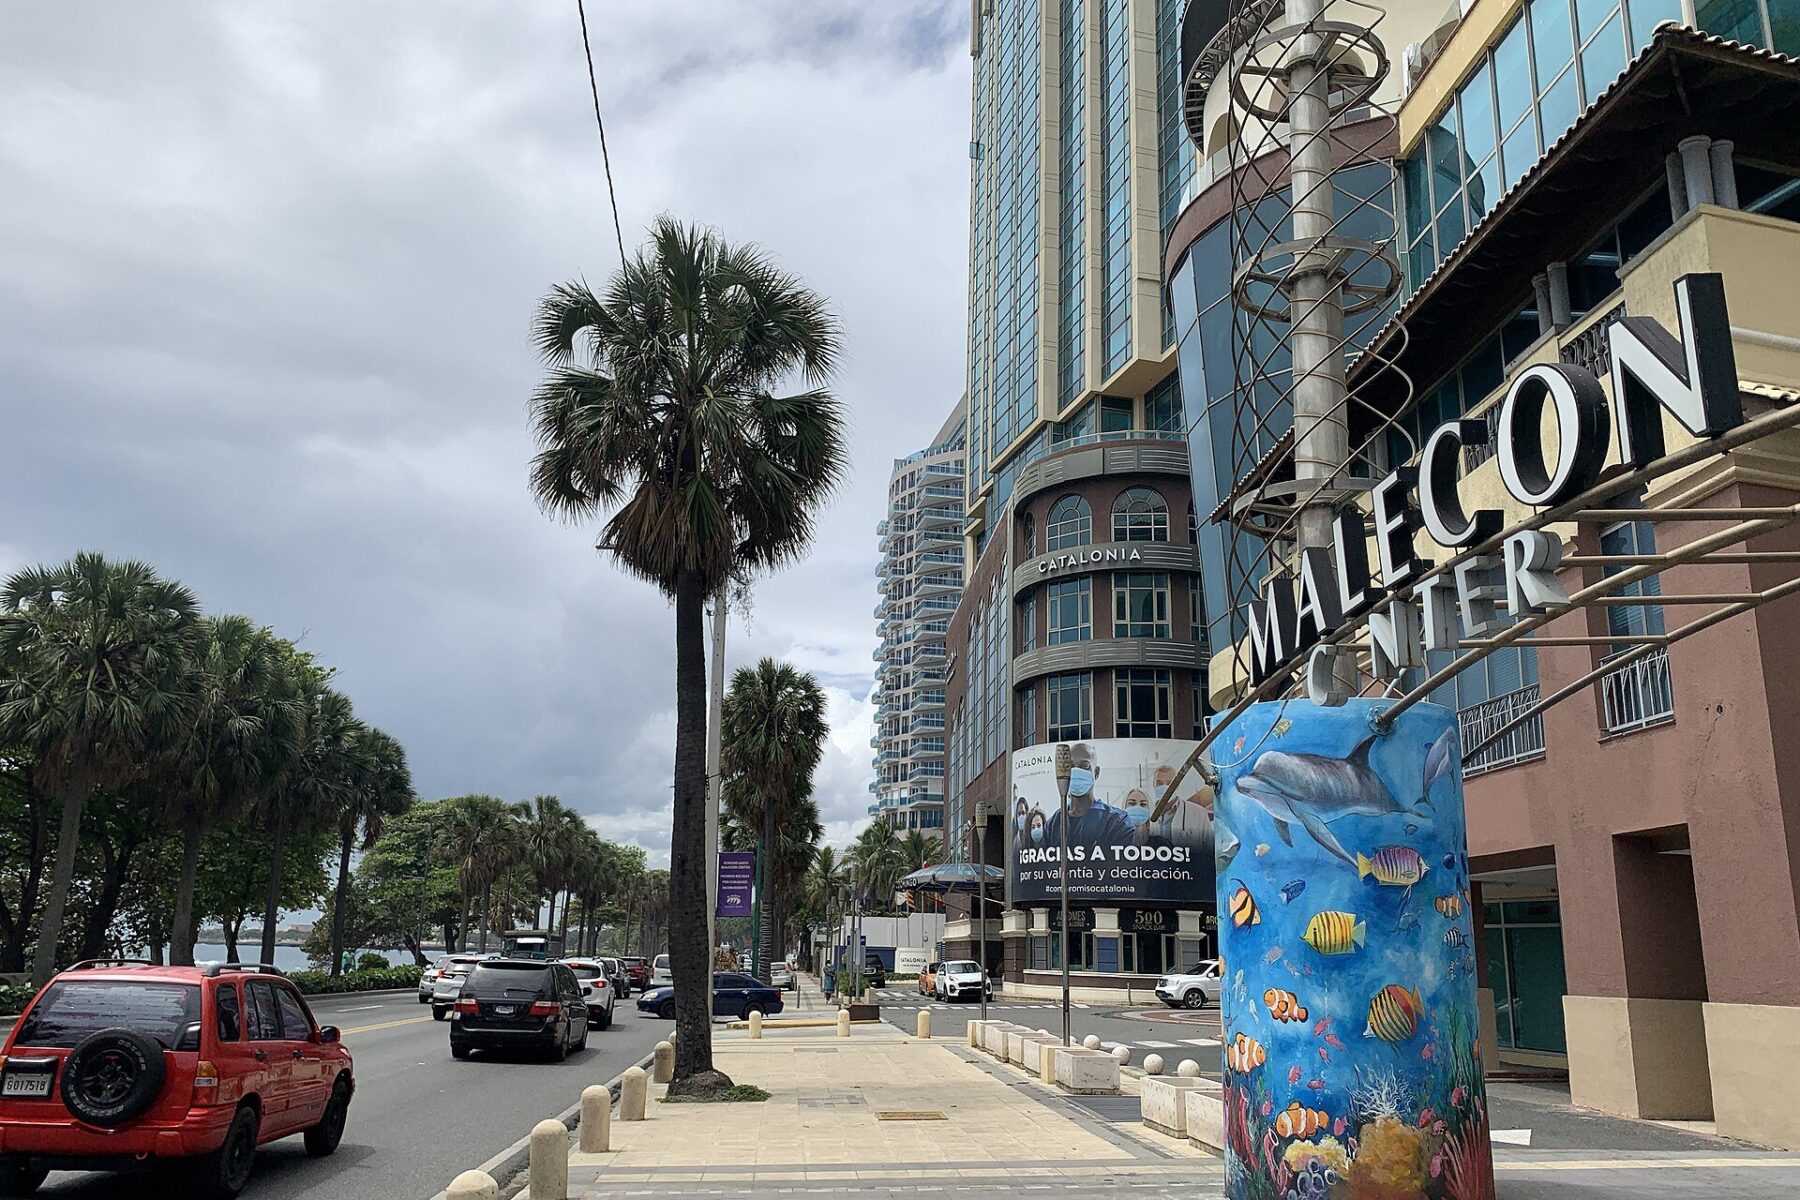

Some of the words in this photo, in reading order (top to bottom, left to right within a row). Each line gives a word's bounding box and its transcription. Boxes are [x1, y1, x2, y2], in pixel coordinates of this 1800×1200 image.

[1248, 272, 1744, 687] MALECON
[1038, 548, 1141, 573] CATALONIA
[1308, 529, 1570, 707] CNTER
[1015, 756, 1053, 769] CATALONIA
[1090, 845, 1106, 861] A
[1110, 845, 1191, 862] TODOS!
[1020, 871, 1032, 883] por
[1033, 870, 1044, 880] su
[1046, 866, 1093, 879] valntía
[1097, 869, 1106, 880] y
[1110, 866, 1194, 880] dedicación.
[1045, 884, 1135, 893] #comromisocatalonia
[1135, 910, 1163, 925] 500
[1132, 923, 1153, 931] SNACK
